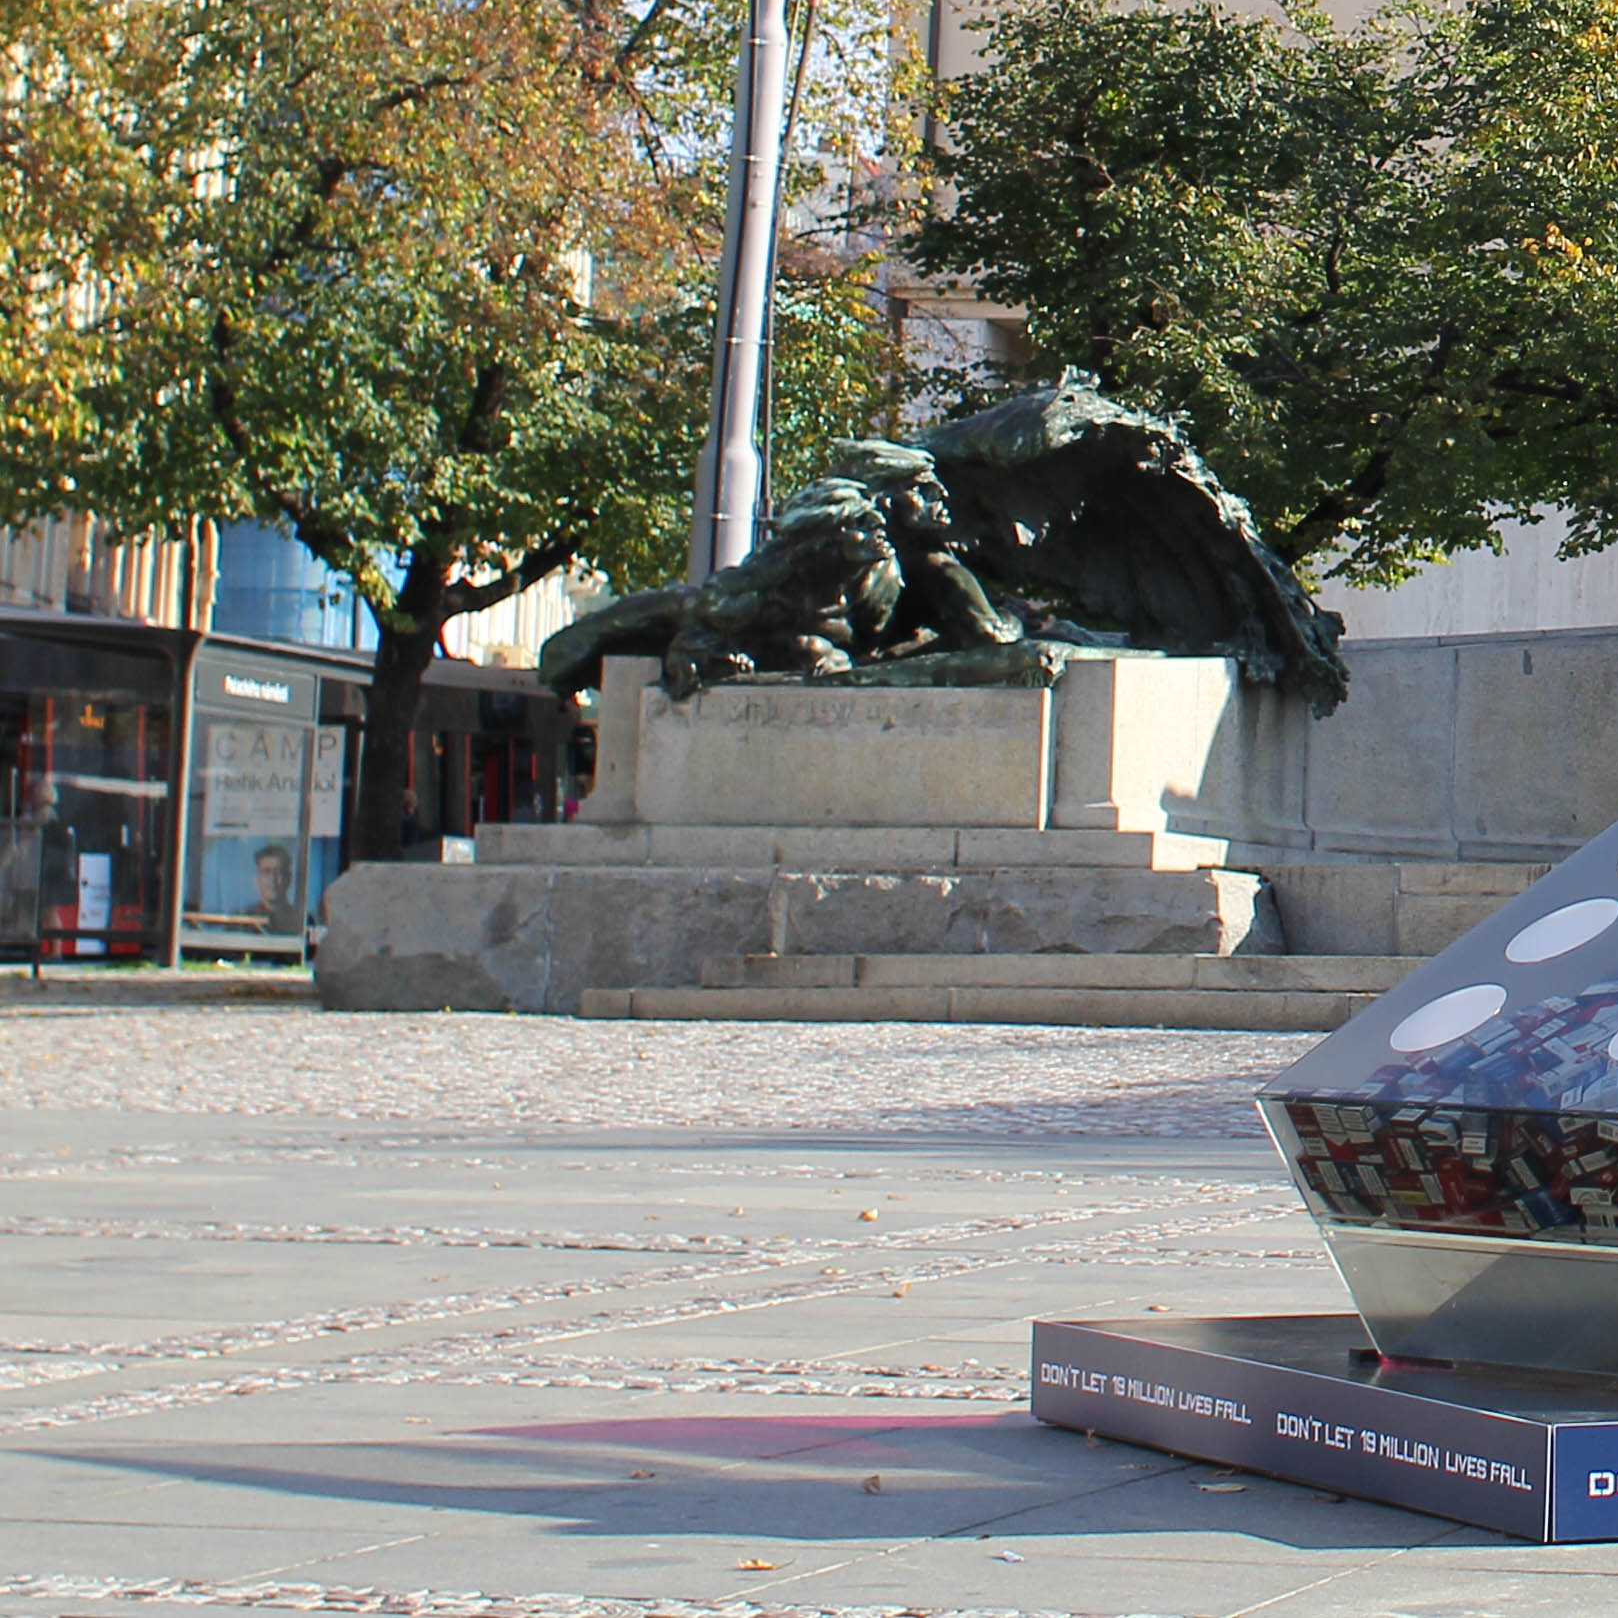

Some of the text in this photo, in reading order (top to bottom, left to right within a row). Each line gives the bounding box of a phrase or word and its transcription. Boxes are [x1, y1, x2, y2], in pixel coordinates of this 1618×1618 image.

[1040, 1362, 1080, 1388] DON'T
[1081, 1370, 1107, 1394] LET
[1127, 1378, 1175, 1408] MILLION
[1178, 1390, 1213, 1416] LIVES
[1214, 1398, 1252, 1424] FALL
[1276, 1412, 1532, 1490] DON'T LET 19 MILLION LIVES FALL
